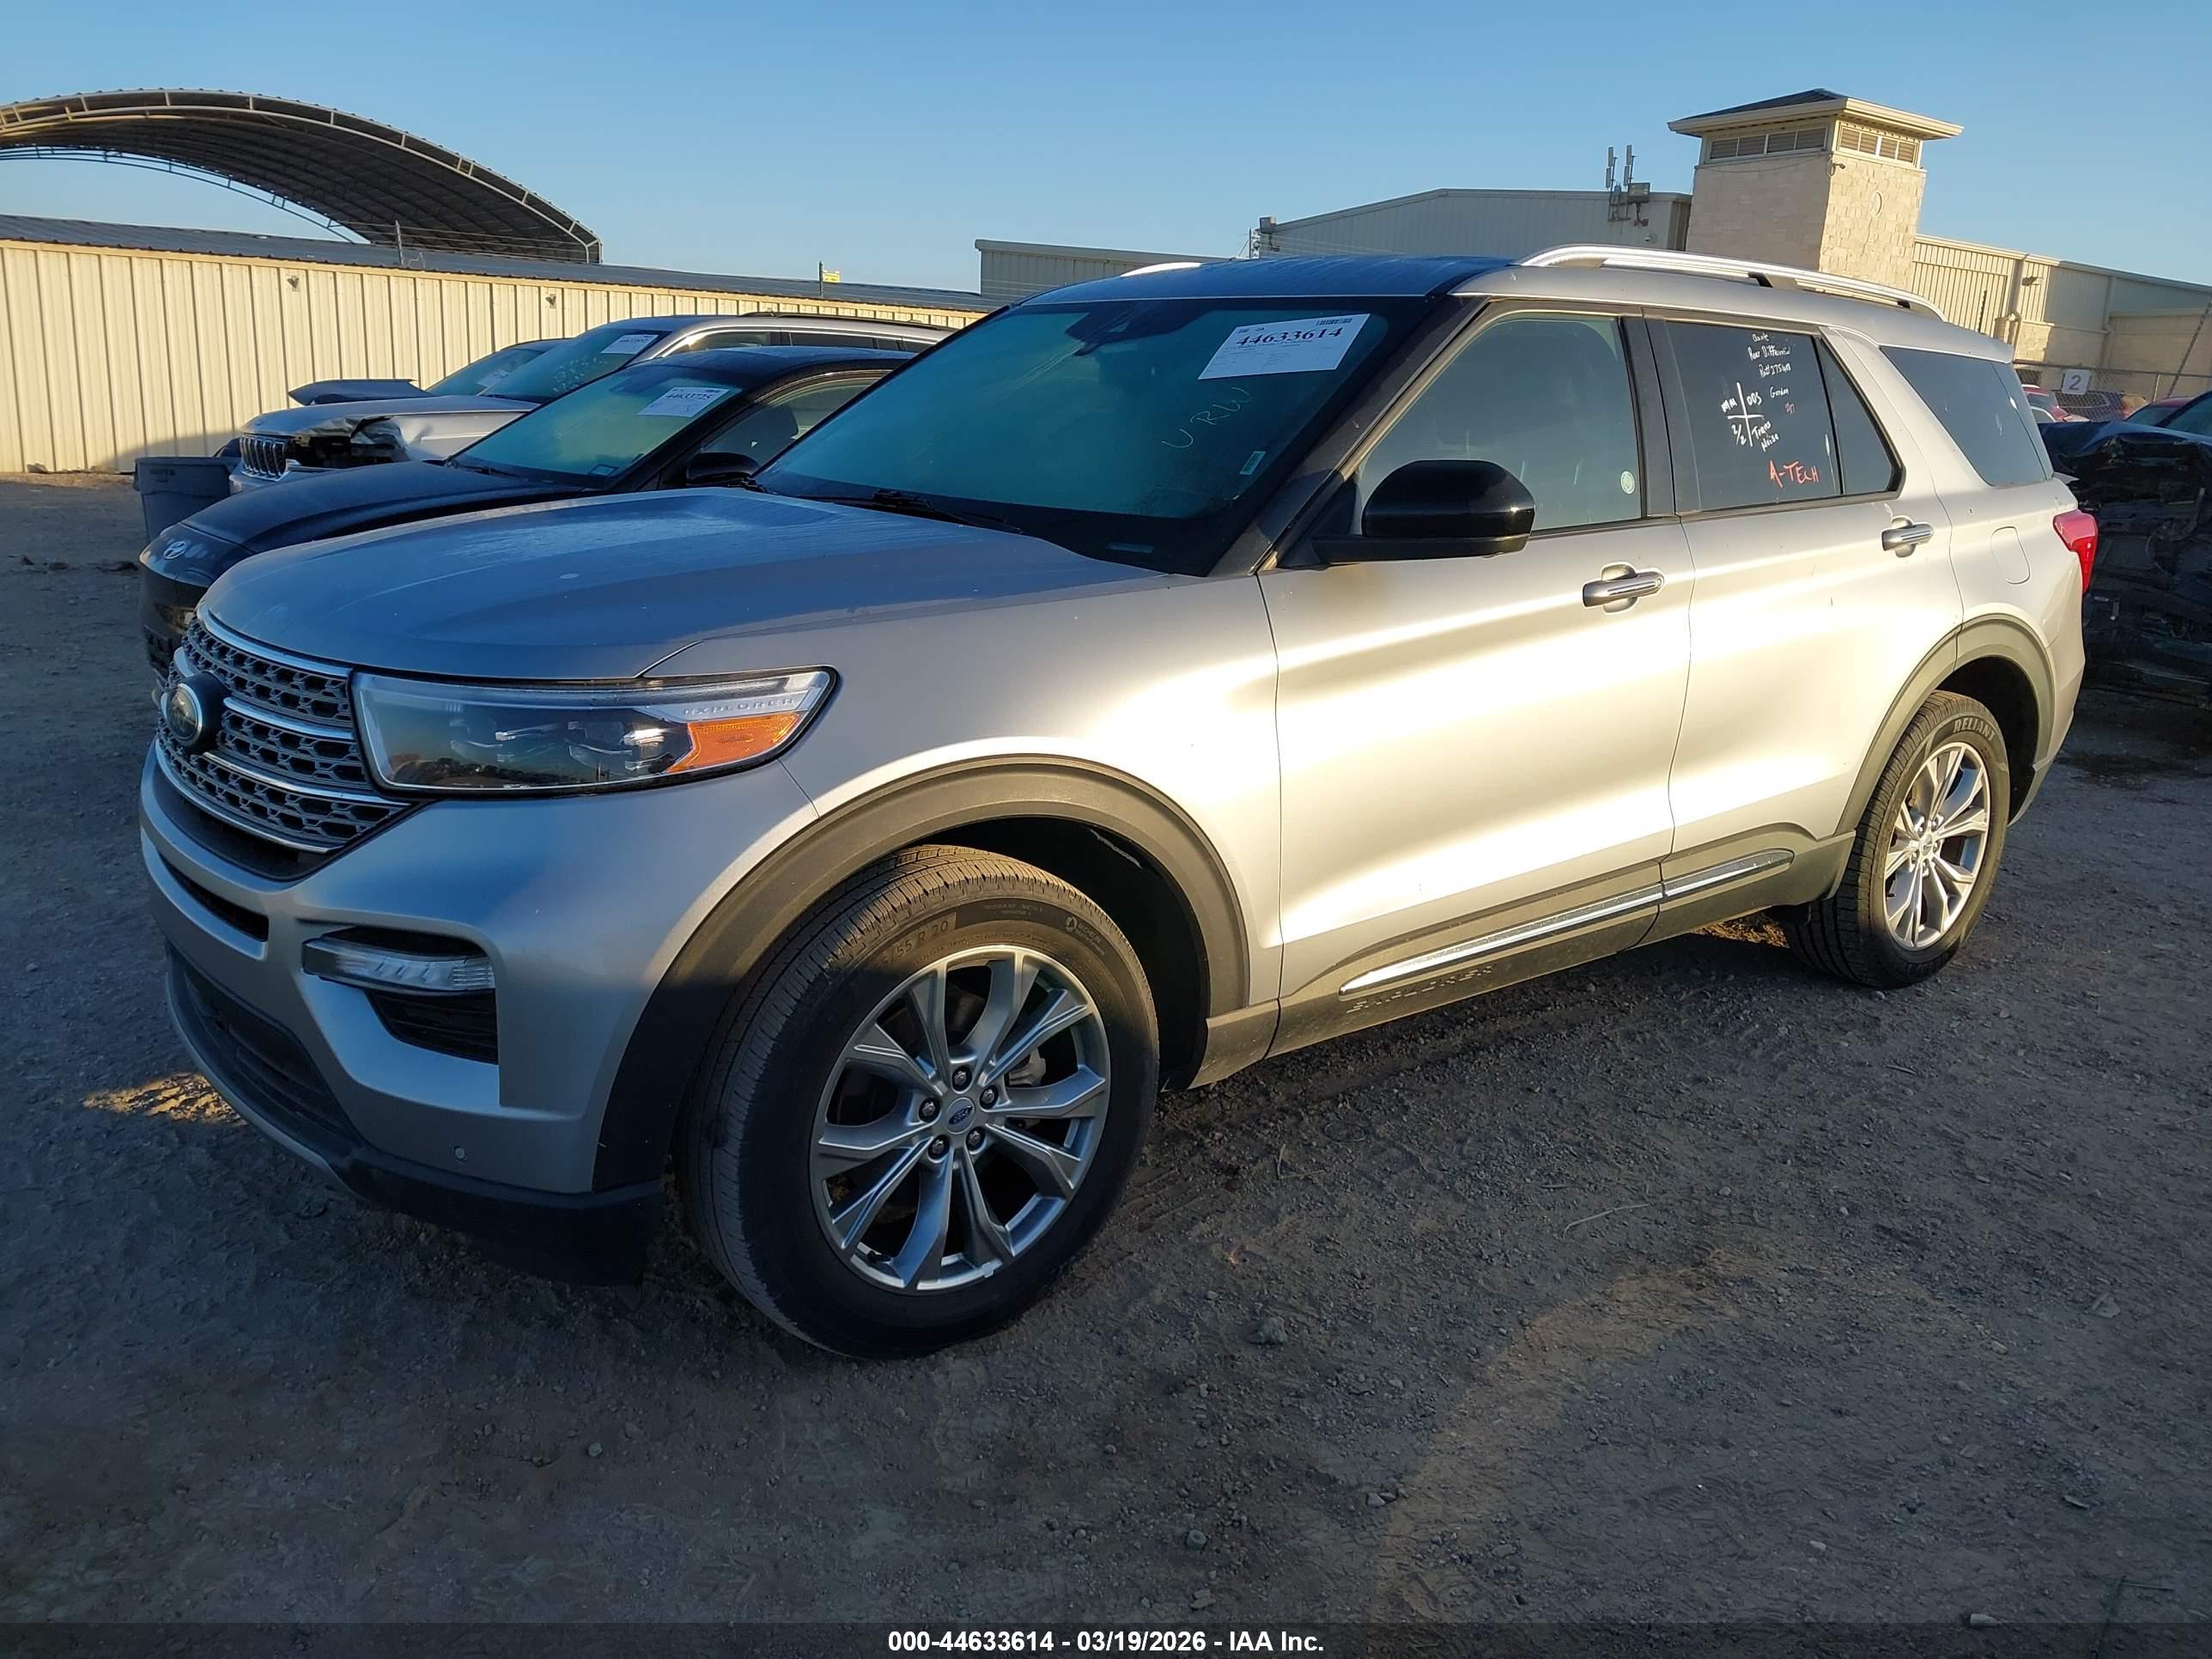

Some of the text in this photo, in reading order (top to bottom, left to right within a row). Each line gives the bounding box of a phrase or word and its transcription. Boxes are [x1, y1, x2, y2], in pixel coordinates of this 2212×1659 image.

[1236, 326, 1344, 345] 44633614
[2069, 374, 2082, 391] 2
[1953, 717, 1996, 741] RELIANT
